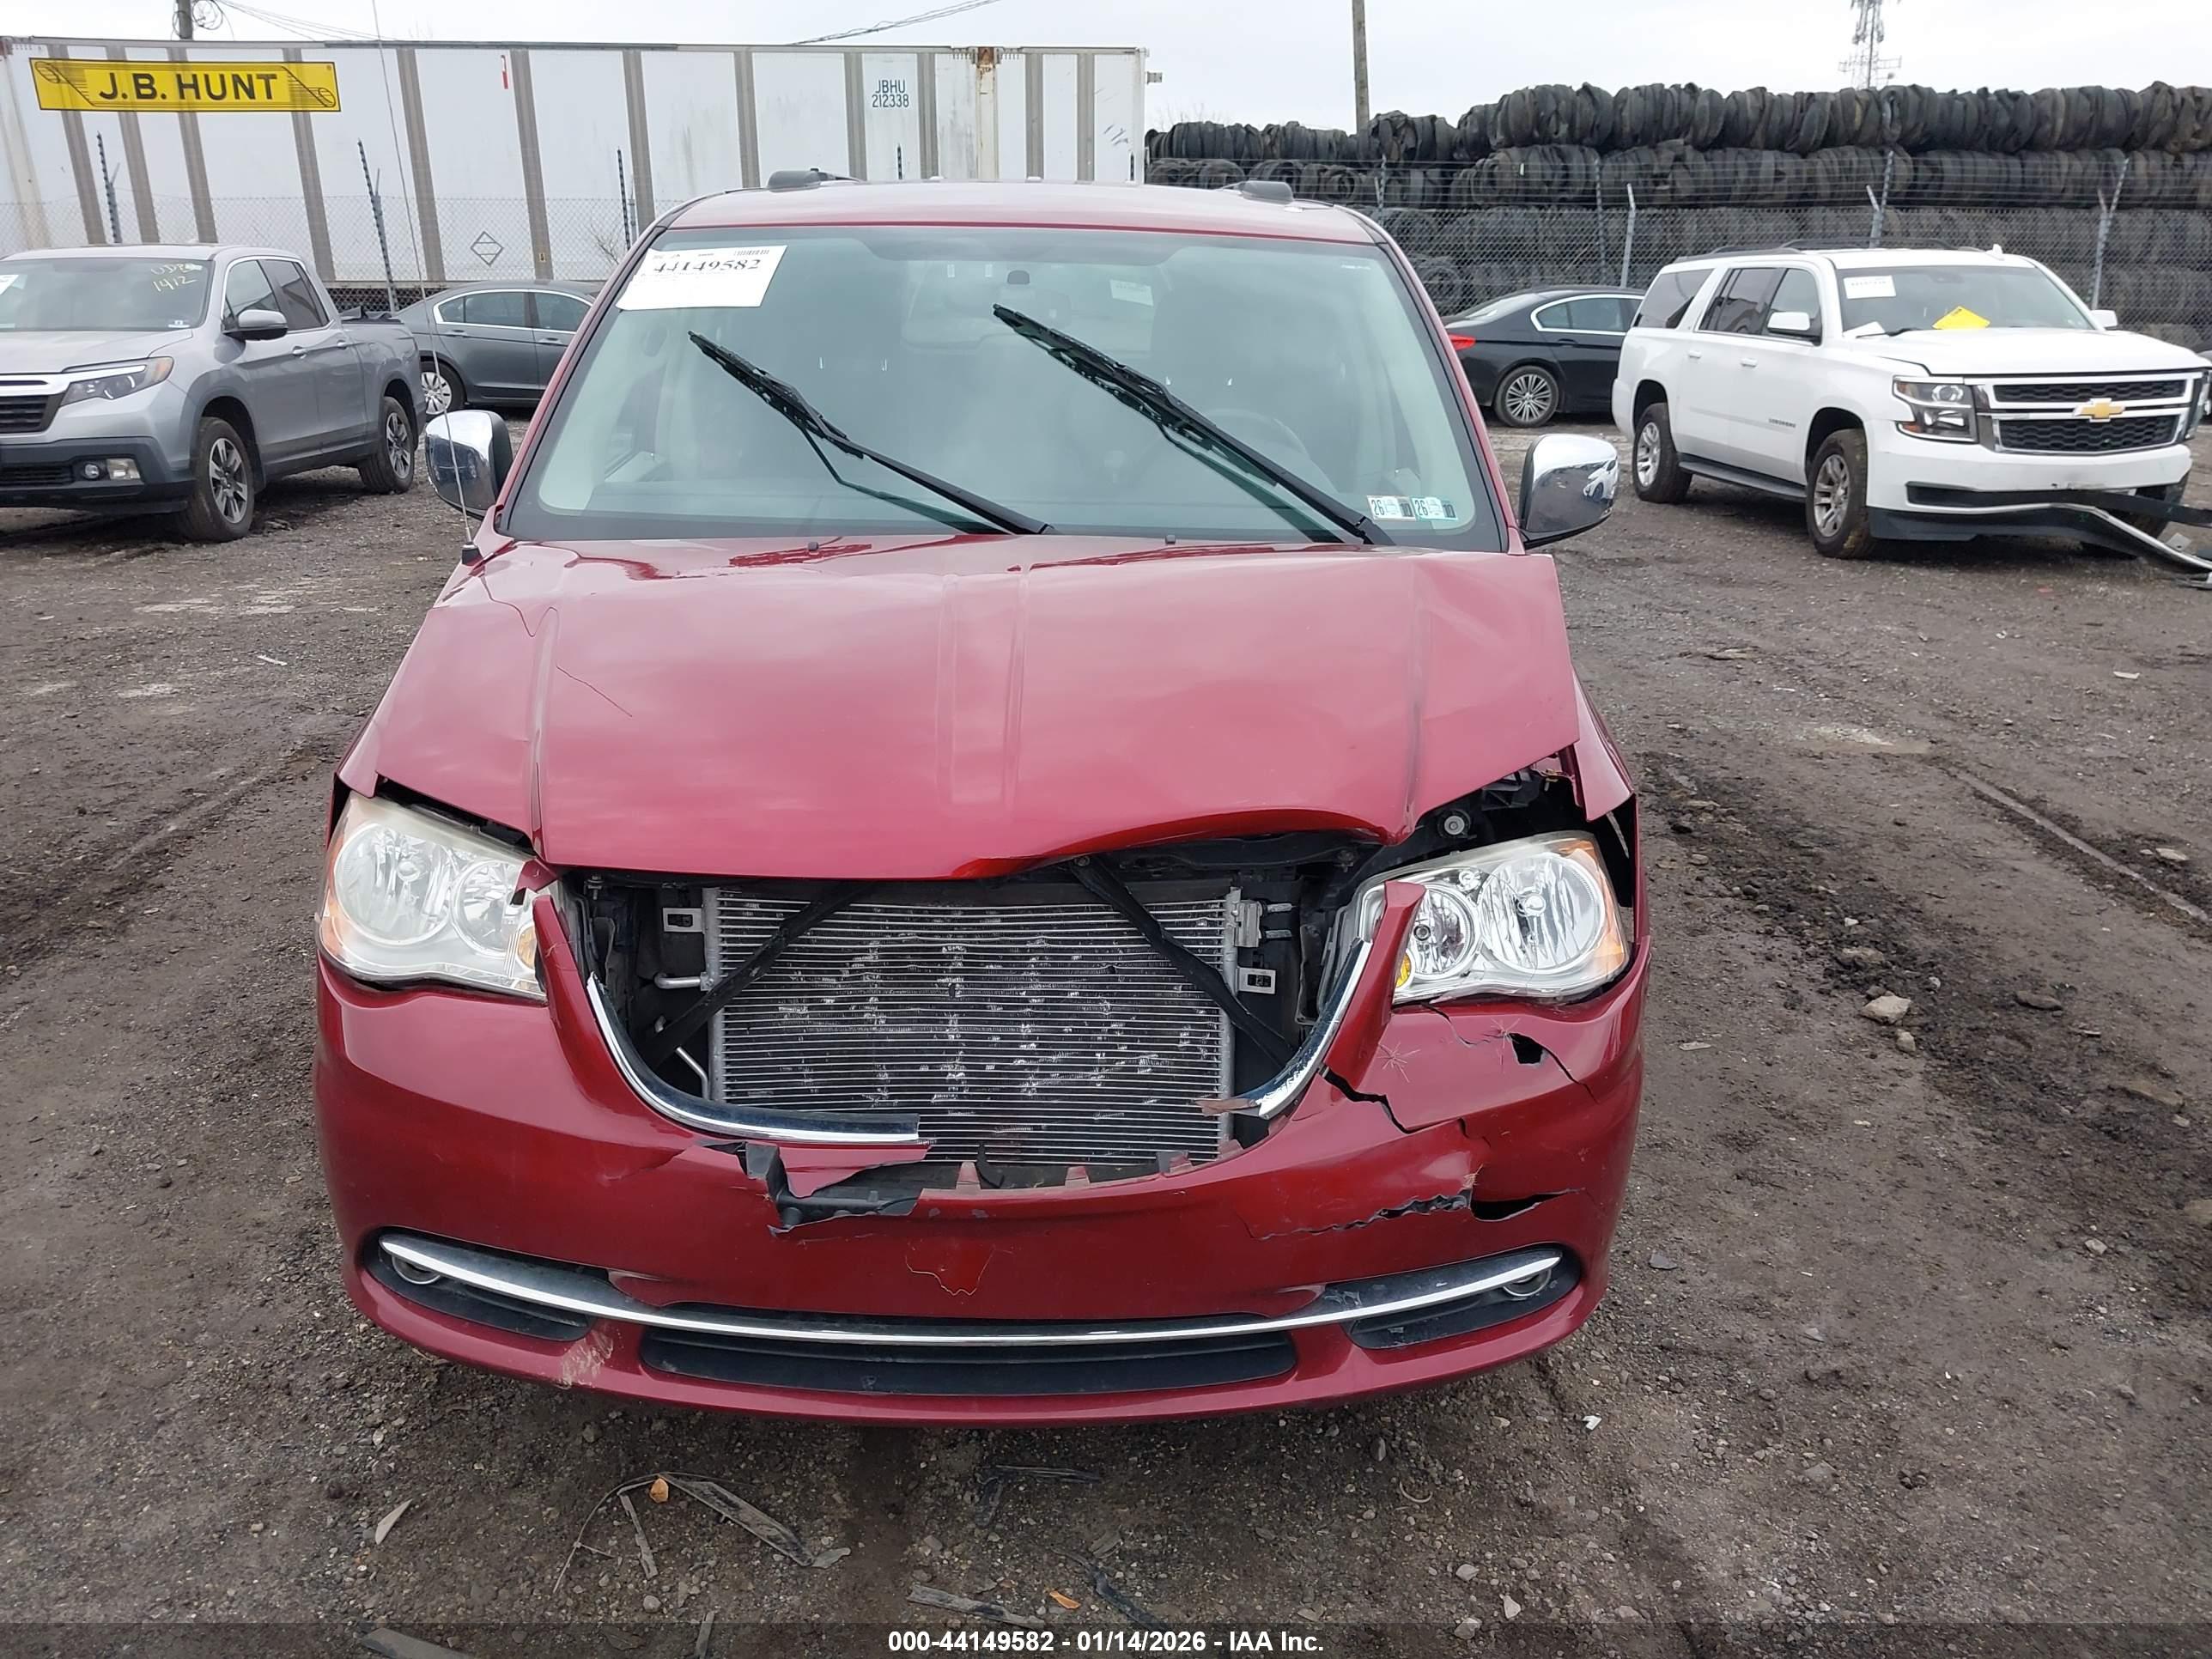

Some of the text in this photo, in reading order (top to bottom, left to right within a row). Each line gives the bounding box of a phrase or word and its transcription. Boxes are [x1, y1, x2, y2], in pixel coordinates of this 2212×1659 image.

[100, 72, 278, 100] J.B. HUNT
[875, 79, 906, 94] JBHU
[872, 94, 910, 108] 212338
[653, 258, 762, 273] 44149582
[1371, 500, 1385, 516] 26
[1415, 500, 1429, 516] 26
